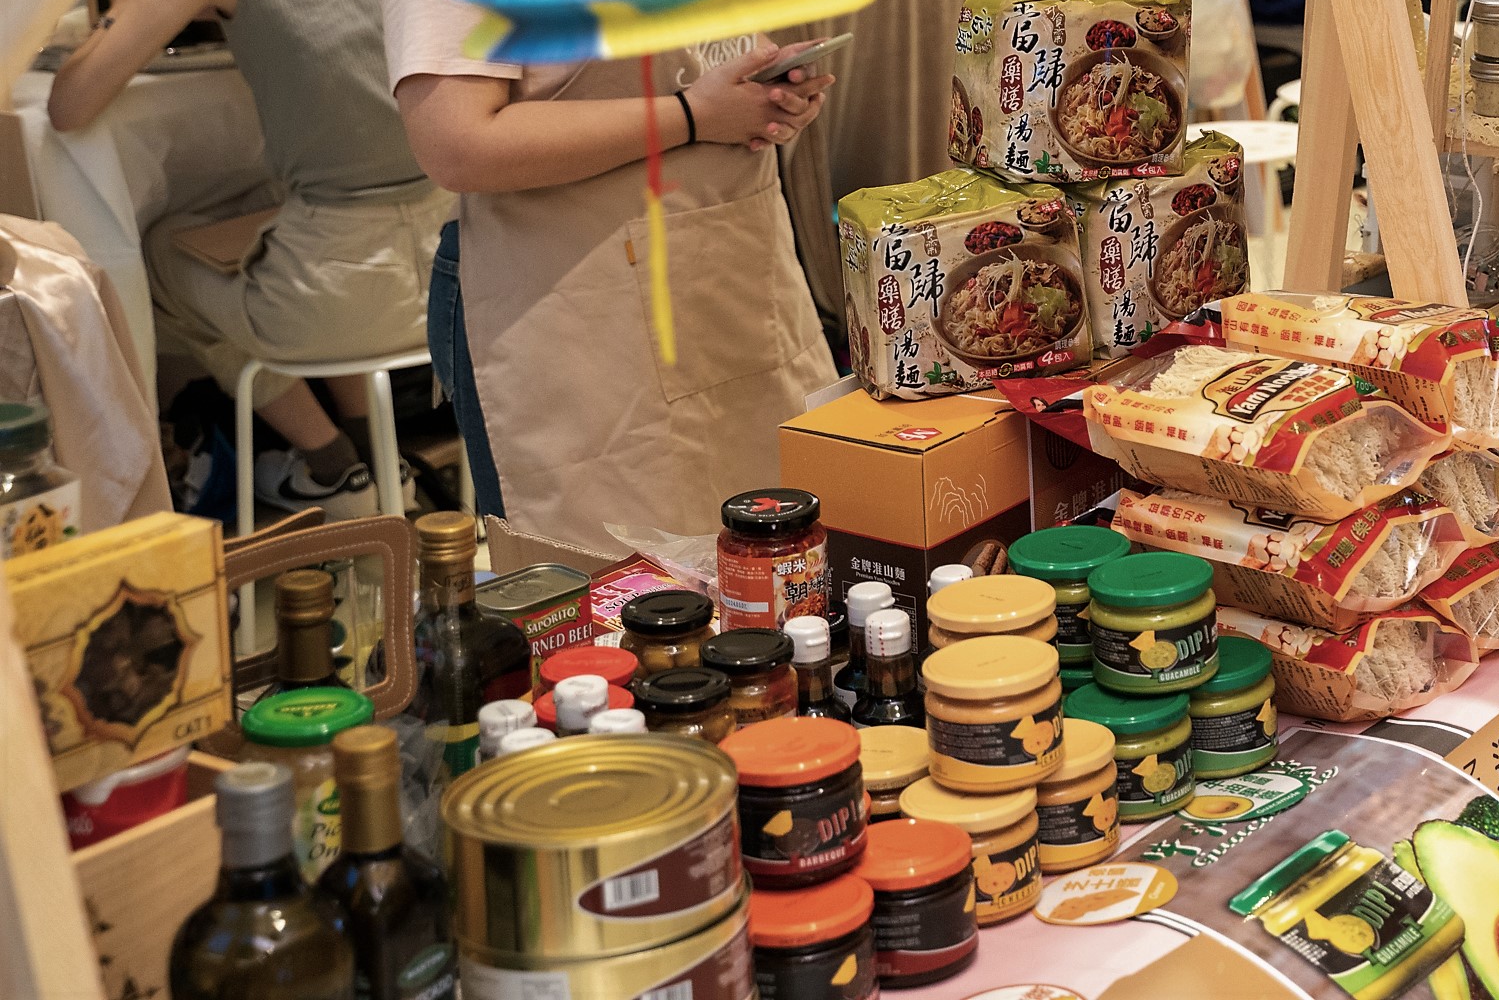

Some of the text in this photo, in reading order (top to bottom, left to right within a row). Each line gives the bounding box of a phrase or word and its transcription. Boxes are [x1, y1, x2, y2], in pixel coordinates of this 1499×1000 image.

[1001, 56, 1024, 113] 藥膳
[1101, 238, 1124, 291] 藥膳
[878, 275, 903, 334] 藥膳
[1229, 388, 1266, 416] Yam
[777, 558, 807, 577] 蝦米
[851, 556, 906, 581] 金牌淮山麵
[526, 606, 577, 635] SAPORITO
[1159, 666, 1201, 682] GUACAMOLE
[817, 800, 857, 844] DIP!
[799, 846, 846, 868] BARBEQUE
[1352, 881, 1402, 930] DIP!
[1375, 927, 1422, 965] GUACAMOLE
